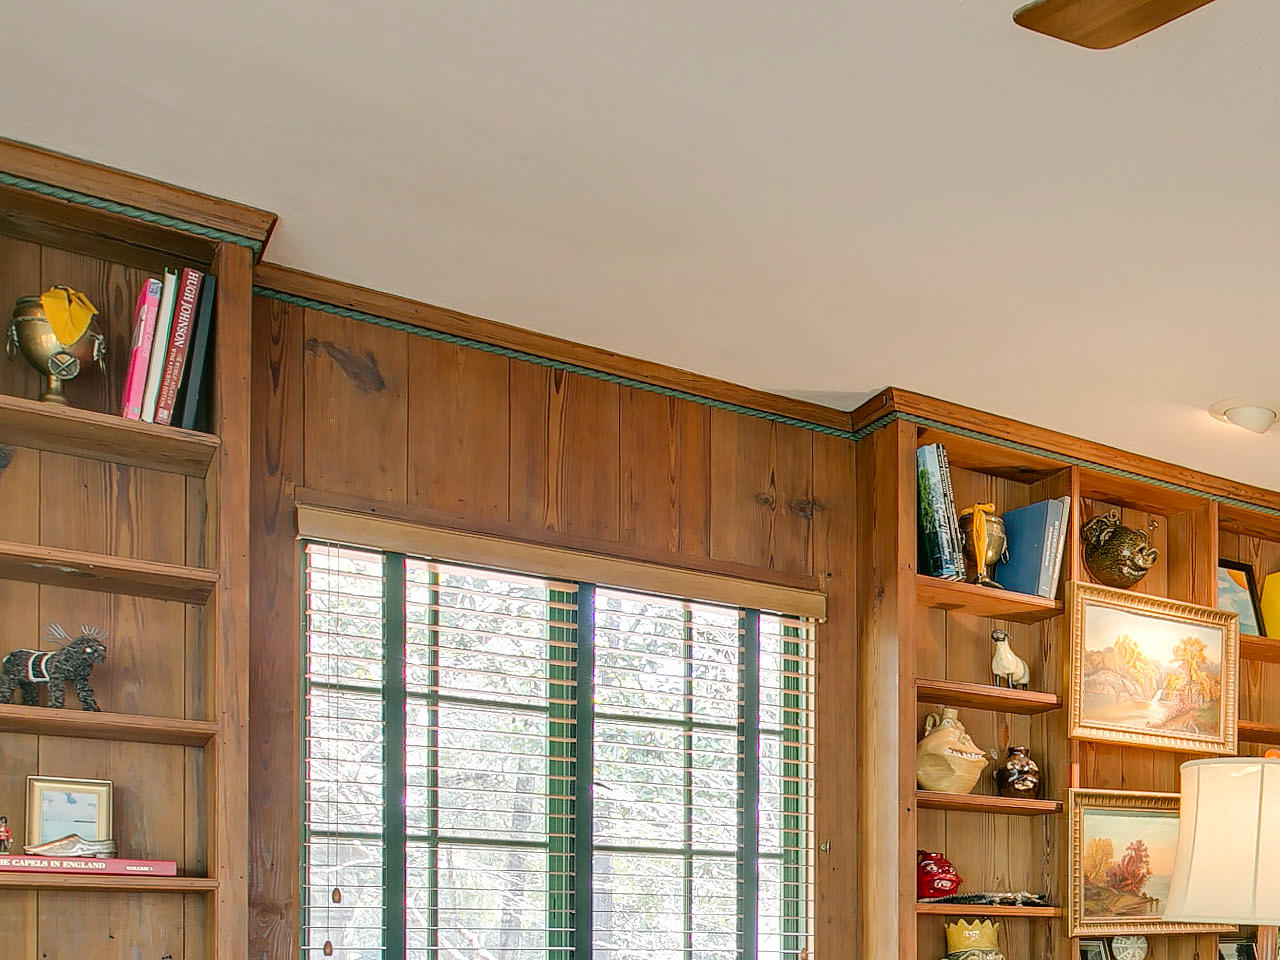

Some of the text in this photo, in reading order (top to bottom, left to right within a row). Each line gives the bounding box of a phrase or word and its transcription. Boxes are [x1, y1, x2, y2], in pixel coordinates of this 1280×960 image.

[174, 270, 199, 348] HUGH JOHNSON
[0, 858, 10, 866] HE
[12, 859, 48, 867] CAPELS
[62, 861, 106, 870] ENGLAND
